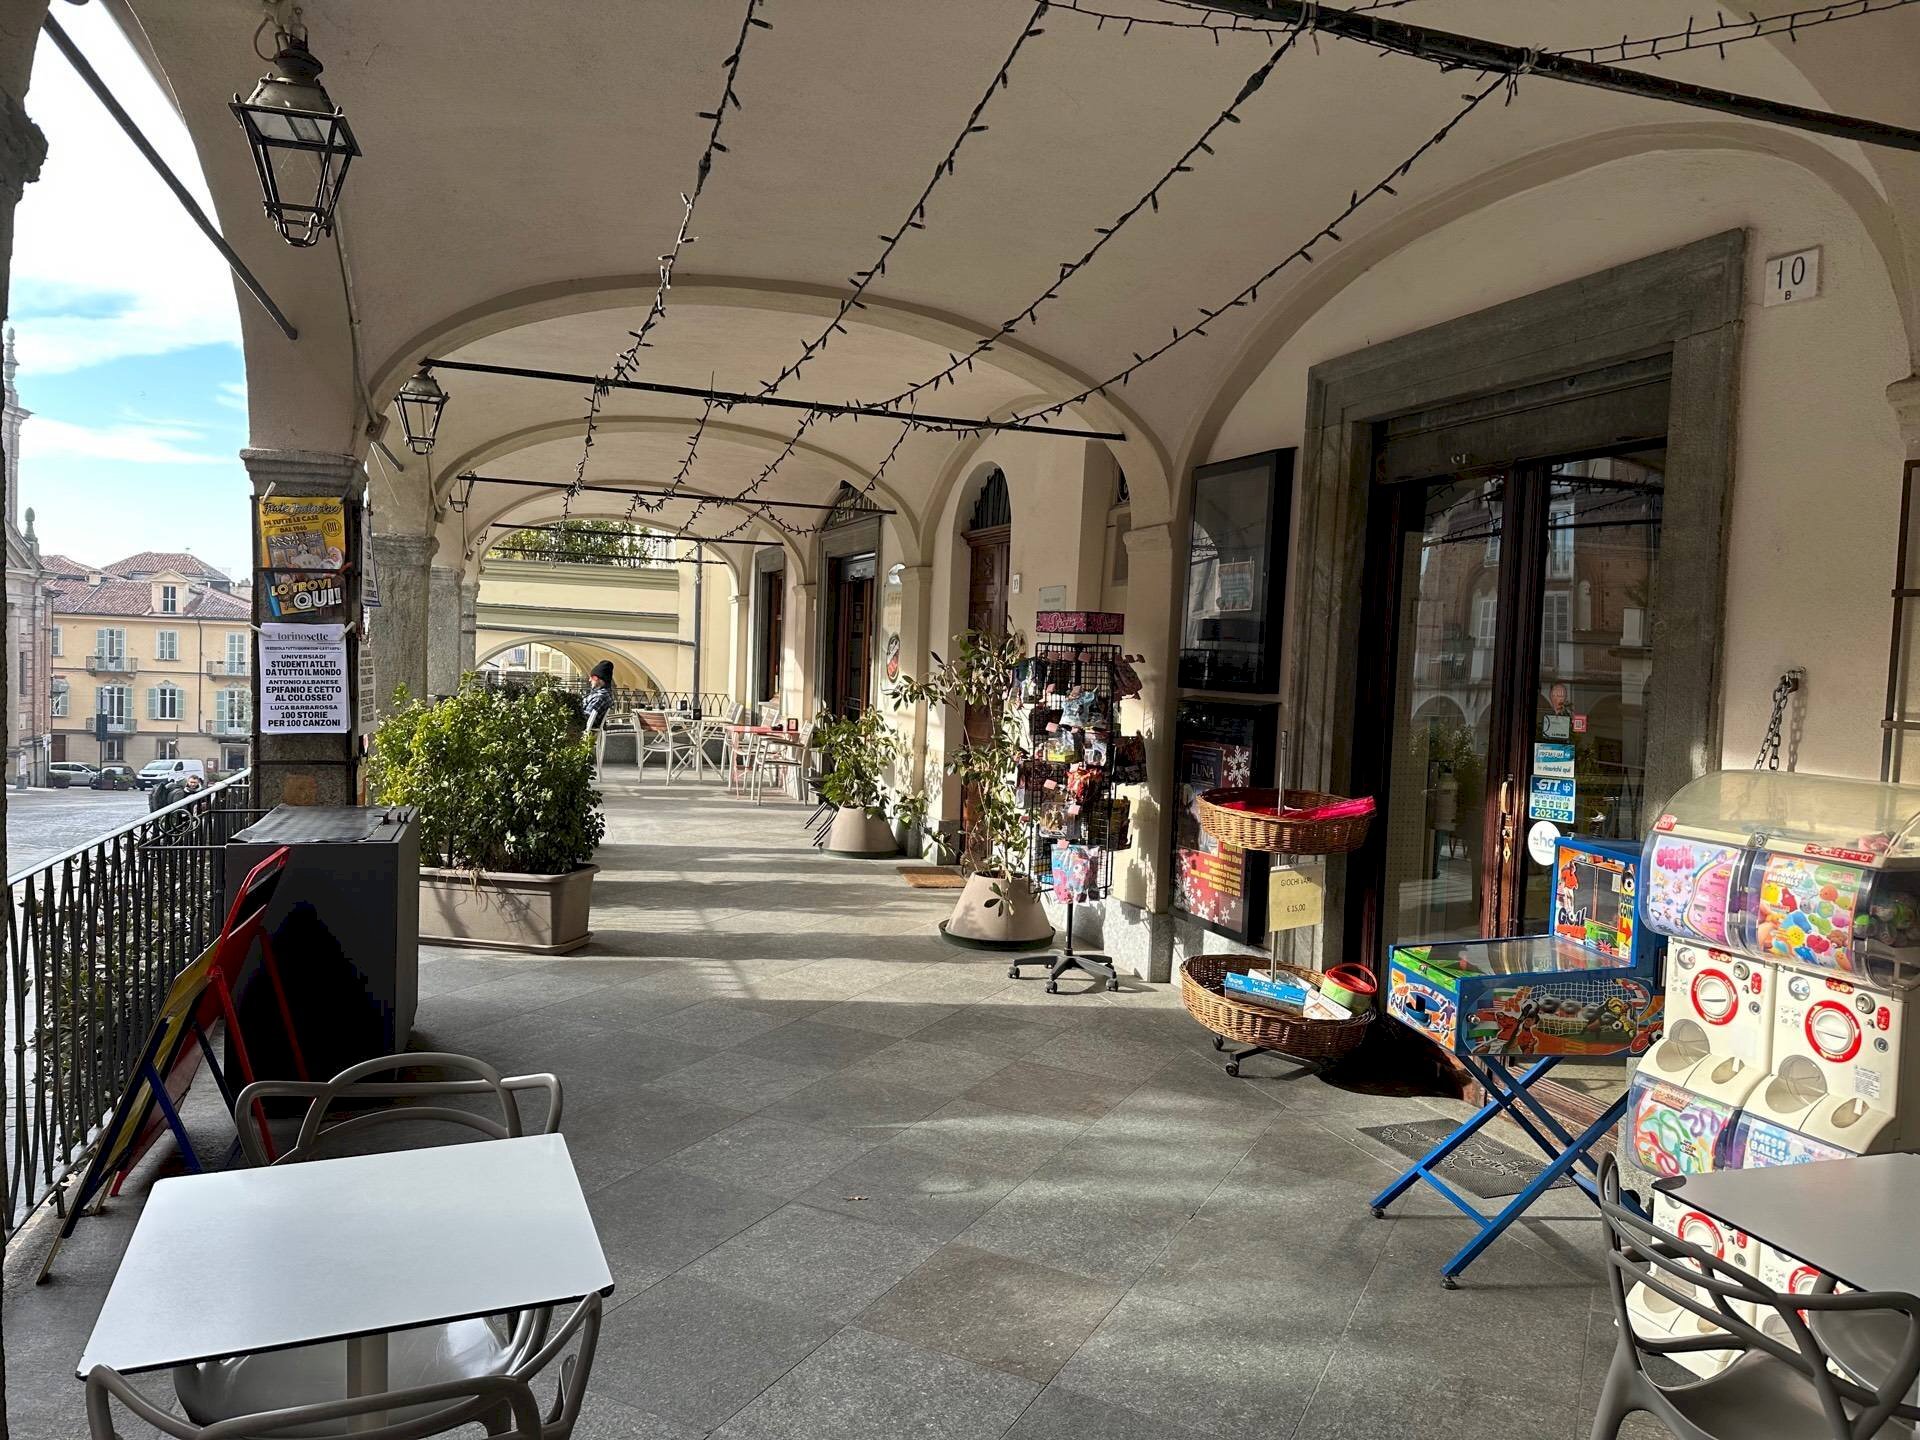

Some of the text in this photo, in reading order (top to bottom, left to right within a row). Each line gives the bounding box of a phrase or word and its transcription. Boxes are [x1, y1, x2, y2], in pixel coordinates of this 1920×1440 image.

[1776, 256, 1805, 289] 10
[1784, 290, 1792, 301] B
[271, 578, 332, 597] LO TROVI
[293, 587, 342, 610] QUI!
[277, 632, 329, 640] torinosette
[297, 711, 328, 719] STORIE
[1191, 763, 1215, 779] LUNA
[1537, 779, 1561, 791] GTT
[1535, 808, 1569, 820] 2021-22
[1750, 1140, 1786, 1162] BALLS
